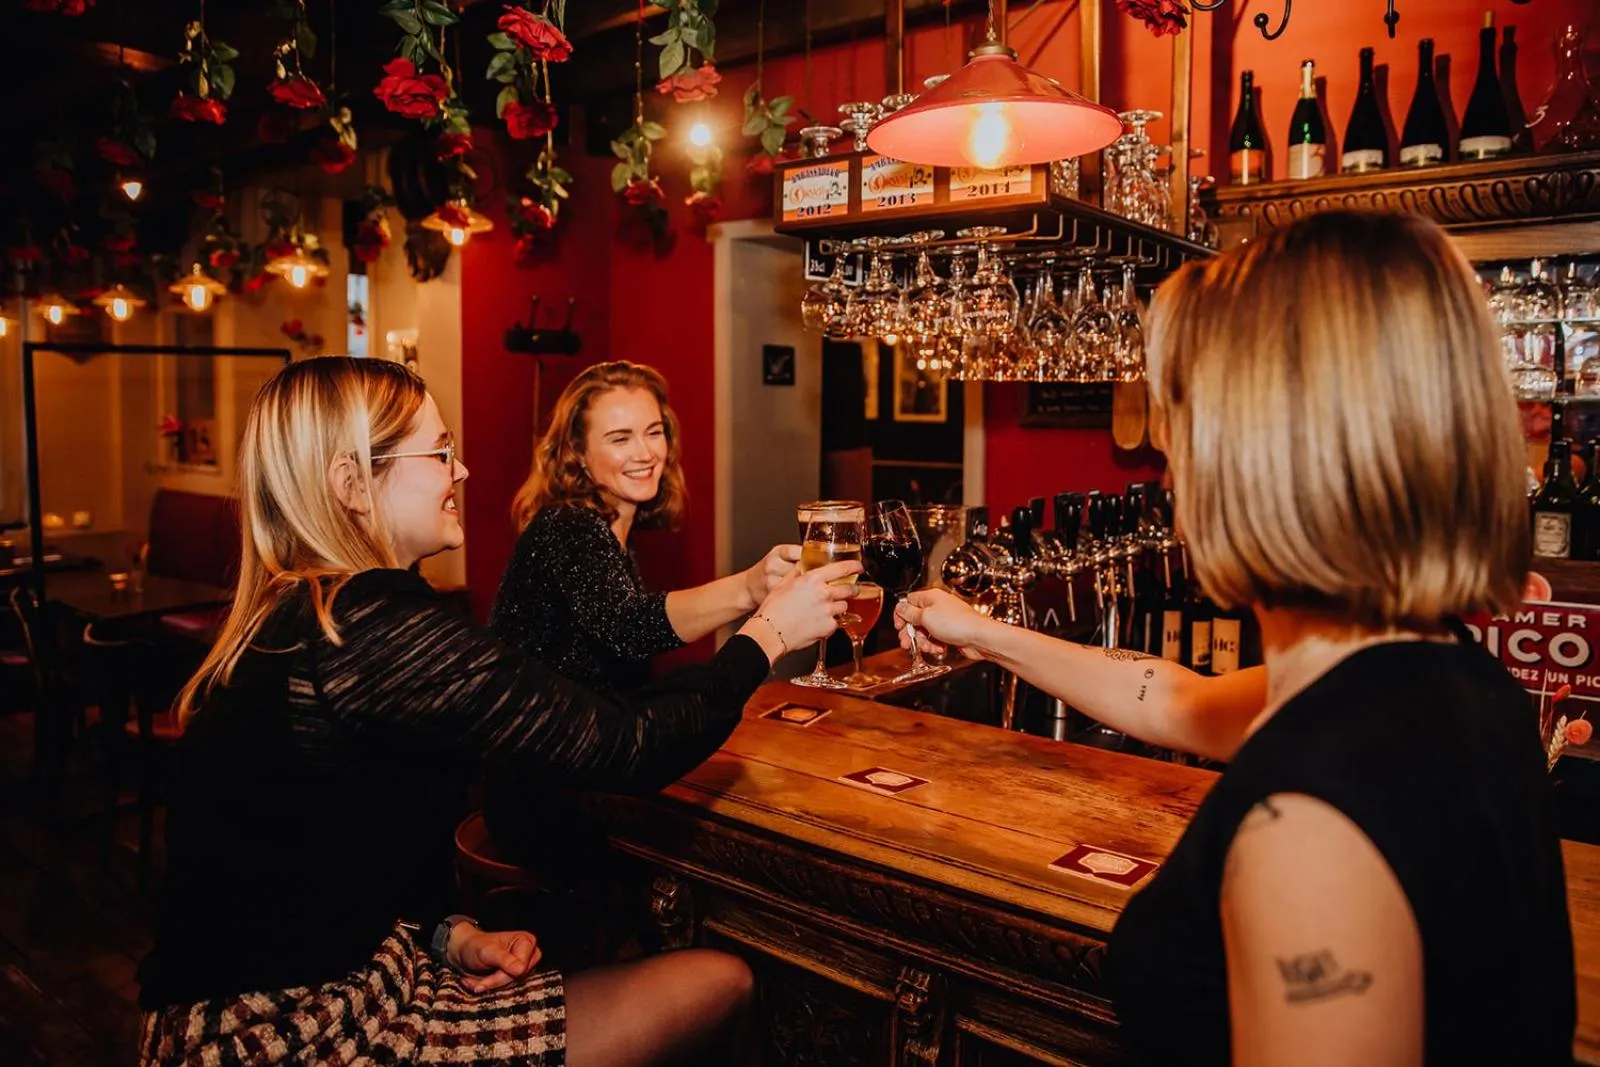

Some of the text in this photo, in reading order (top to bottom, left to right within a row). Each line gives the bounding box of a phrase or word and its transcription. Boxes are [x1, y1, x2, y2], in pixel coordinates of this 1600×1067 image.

[877, 193, 916, 208] 2013
[797, 203, 832, 218] 2012
[1491, 611, 1587, 628] AMER
[1506, 666, 1539, 681] DEZ
[1547, 671, 1569, 683] UN
